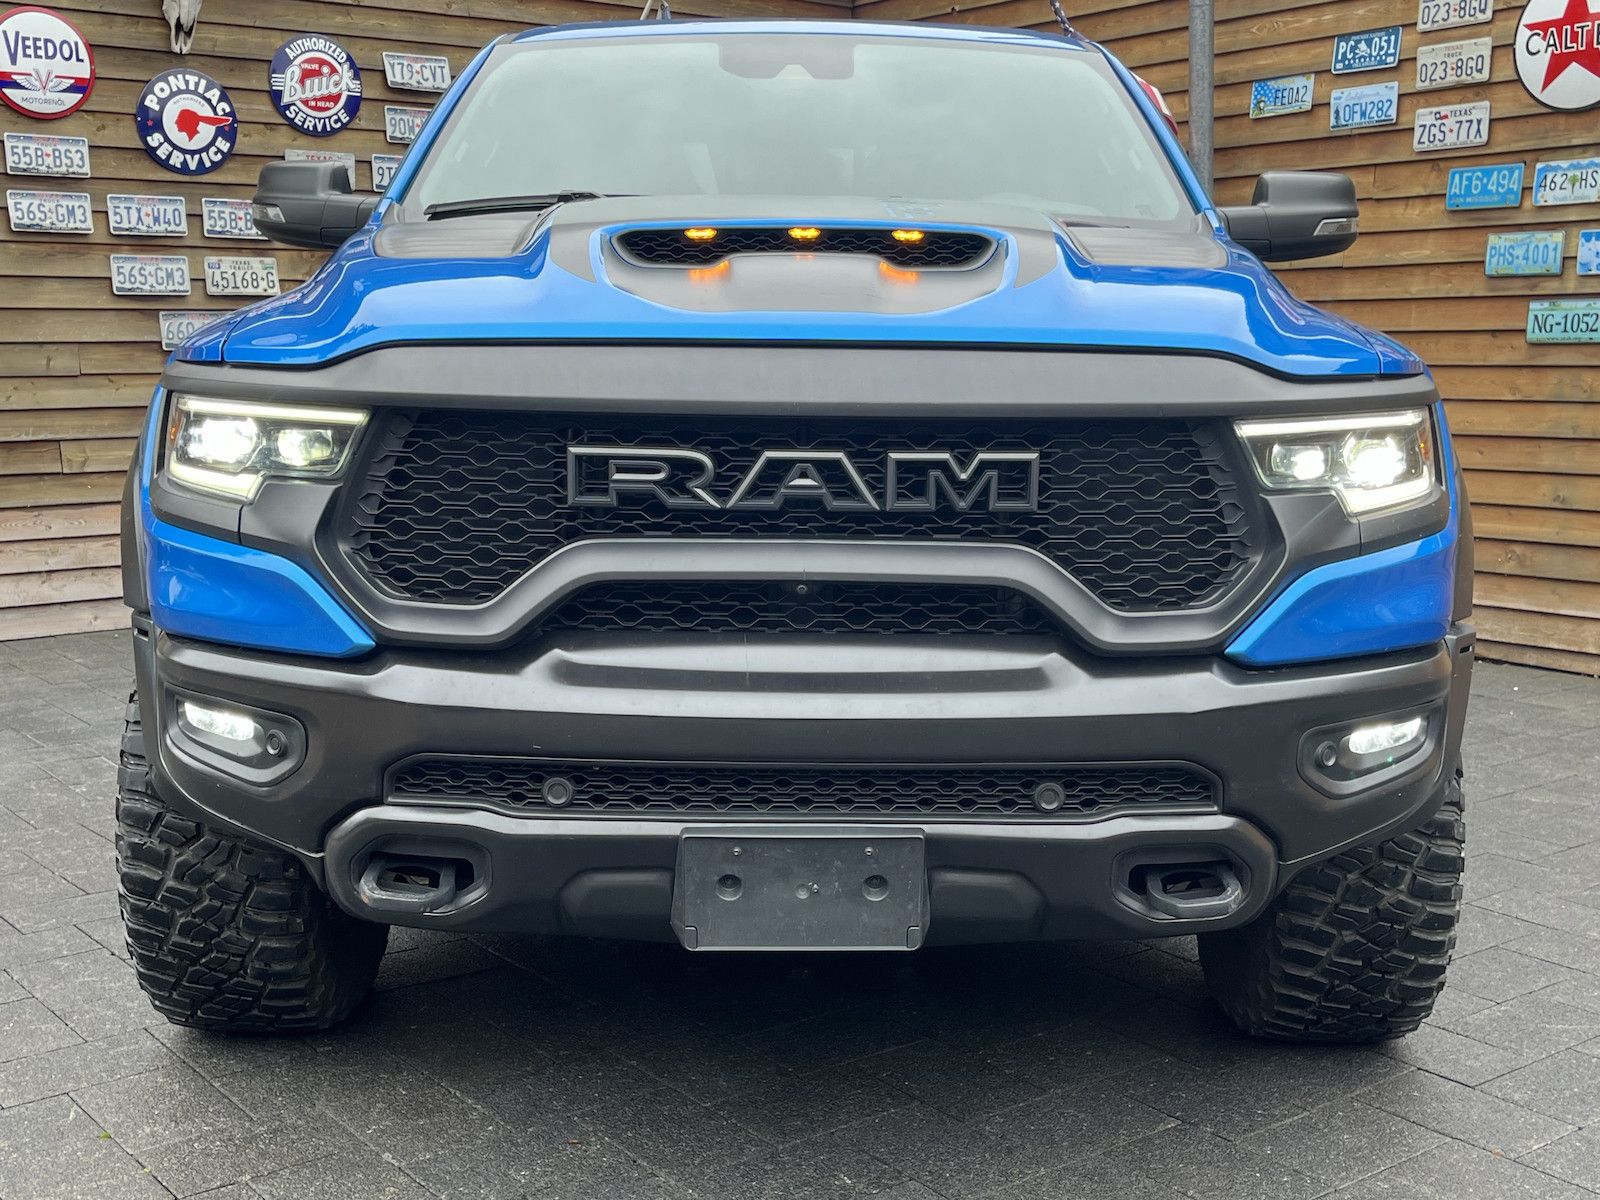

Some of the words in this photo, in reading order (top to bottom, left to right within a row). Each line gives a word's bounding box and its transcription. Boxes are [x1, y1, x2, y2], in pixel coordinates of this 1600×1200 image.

[1421, 2, 1451, 25] 023
[2, 30, 84, 66] VEEDOL
[285, 37, 347, 63] AUTHORIZED
[1337, 40, 1355, 60] PC
[388, 61, 414, 80] Y79
[420, 64, 446, 83] CVT
[1420, 60, 1448, 83] 023
[1455, 54, 1485, 78] 8GQ
[144, 74, 231, 116] PONTIAC
[281, 62, 355, 105] Buick
[285, 105, 350, 132] SERVICE
[1450, 107, 1473, 118] TEXAS
[1455, 117, 1483, 141] 77X
[10, 144, 45, 167] 55B
[146, 132, 231, 170] SERVICE
[1539, 172, 1569, 192] 462
[13, 201, 48, 222] 56S
[55, 203, 88, 224] GM3
[112, 205, 145, 226] 5TX
[207, 209, 238, 230] 55B
[116, 265, 148, 286] 56S
[155, 267, 186, 287] GM3
[211, 270, 260, 289] 45168
[1531, 312, 1599, 334] NG-1052
[566, 444, 1040, 512] RAM
